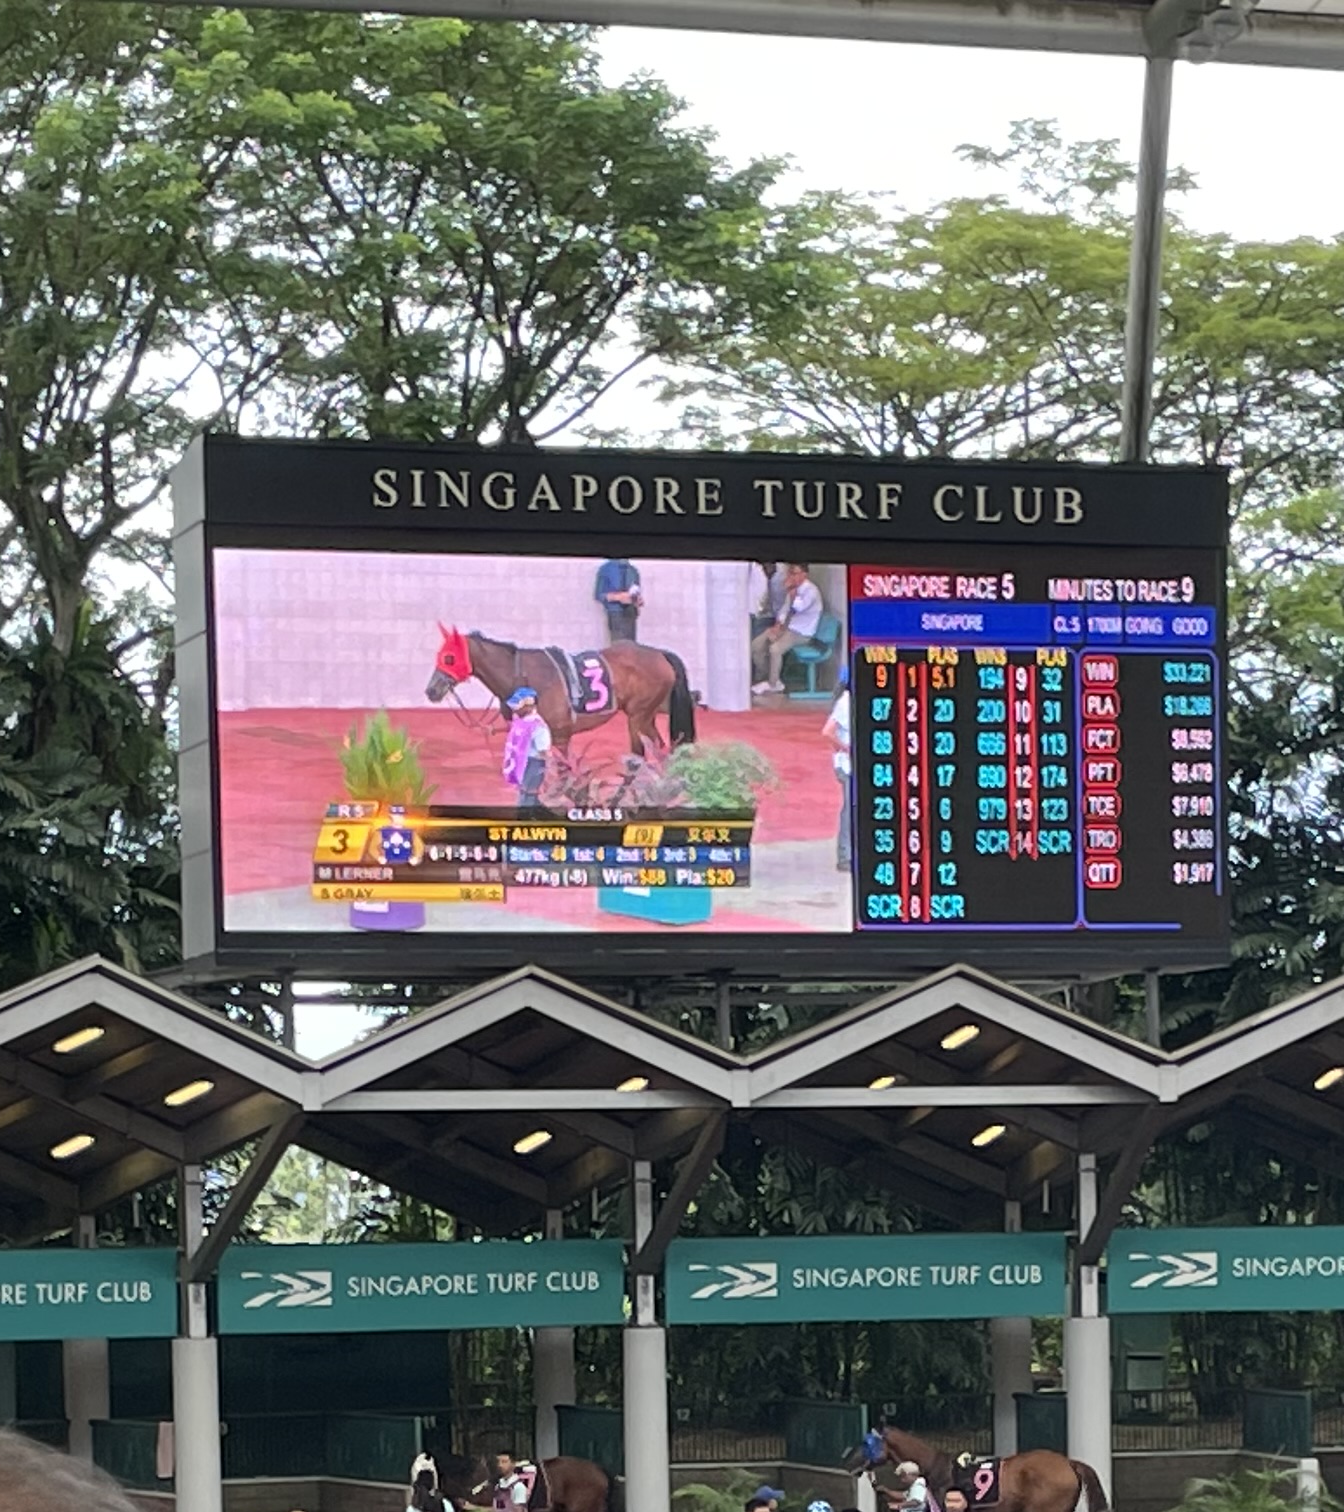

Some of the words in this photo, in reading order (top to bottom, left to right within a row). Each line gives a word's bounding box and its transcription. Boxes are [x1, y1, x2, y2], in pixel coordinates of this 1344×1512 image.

[372, 469, 724, 516] SINGAPORE
[753, 479, 903, 520] TURF
[932, 485, 1084, 525] CLUB
[863, 574, 950, 598] SINGAPORE
[956, 575, 997, 599] RACE
[1001, 573, 1015, 599] 5
[1048, 579, 1114, 601] MINUTES
[1115, 579, 1136, 601] TO
[1182, 576, 1195, 602] 9
[921, 612, 984, 632] SINGAPORE
[908, 665, 916, 687] 1
[1015, 667, 1028, 691] 9
[1084, 661, 1114, 682] WIN
[582, 666, 608, 712] 3
[907, 699, 918, 722] 2
[1014, 700, 1031, 723] 10
[1043, 701, 1061, 724] 31
[1086, 694, 1114, 716] PLA
[907, 731, 919, 755] 3
[1014, 733, 1031, 756] 11
[1040, 733, 1067, 756] 113
[1087, 728, 1115, 749] FCT
[907, 765, 919, 787] 4
[936, 764, 955, 787] 17
[1015, 766, 1033, 789] 12
[1041, 766, 1067, 788] 174
[567, 808, 612, 821] CLASS
[908, 798, 920, 820] 5
[1015, 798, 1033, 821] 13
[1088, 796, 1115, 817] TCE
[329, 829, 350, 854] 3
[488, 827, 509, 841] ST
[512, 827, 567, 841] ALWYN
[873, 829, 894, 853] 35
[908, 830, 920, 853] 6
[940, 830, 952, 853] 9
[975, 829, 1009, 854] SCR
[1013, 831, 1032, 854] 14
[1038, 830, 1072, 854] SCR
[514, 869, 559, 887] 477kg
[909, 863, 920, 885] 7
[937, 862, 957, 885] 12
[867, 895, 902, 918] SCR
[910, 895, 921, 918] 8
[930, 895, 964, 919] SCR
[346, 1272, 479, 1298] SINGAPORE
[485, 1270, 539, 1294] TURF
[545, 1270, 601, 1293] CLUB
[791, 1265, 922, 1289] SINGAPORE
[928, 1264, 982, 1287] TURF
[987, 1263, 1043, 1286] CLUB
[34, 1281, 89, 1305] TURF
[95, 1280, 153, 1304] CLUB
[973, 1468, 994, 1501] 9
